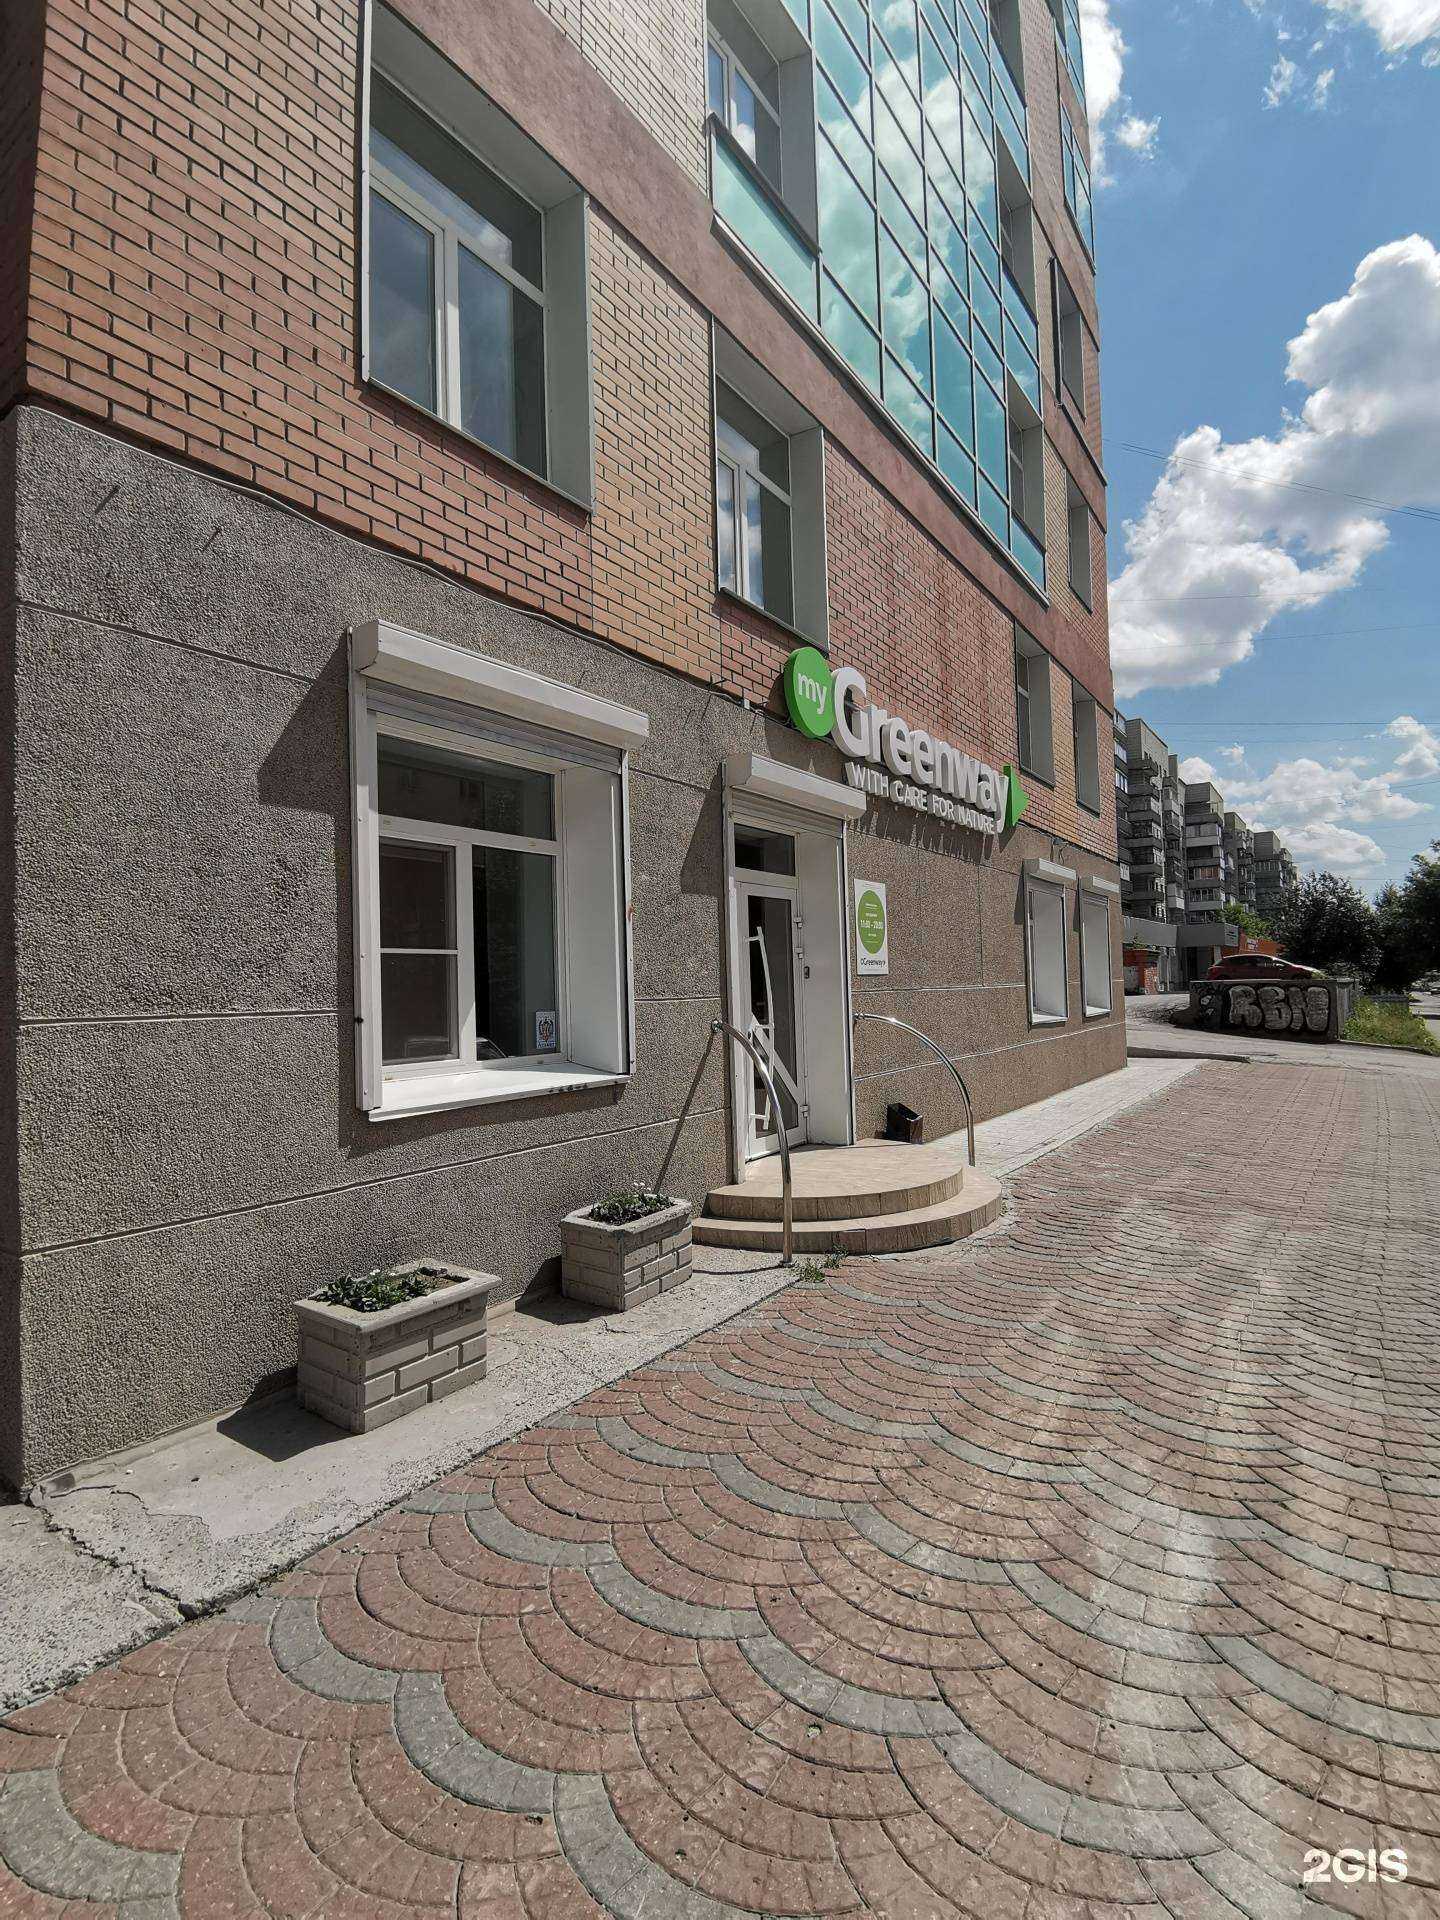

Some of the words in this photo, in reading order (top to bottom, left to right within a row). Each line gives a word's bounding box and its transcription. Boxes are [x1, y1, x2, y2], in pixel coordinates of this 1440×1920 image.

[798, 672, 827, 716] my
[831, 666, 1009, 834] Greenway
[845, 761, 889, 798] WITH
[890, 780, 928, 812] CARE
[930, 794, 955, 821] FOR
[953, 806, 995, 836] NATURE
